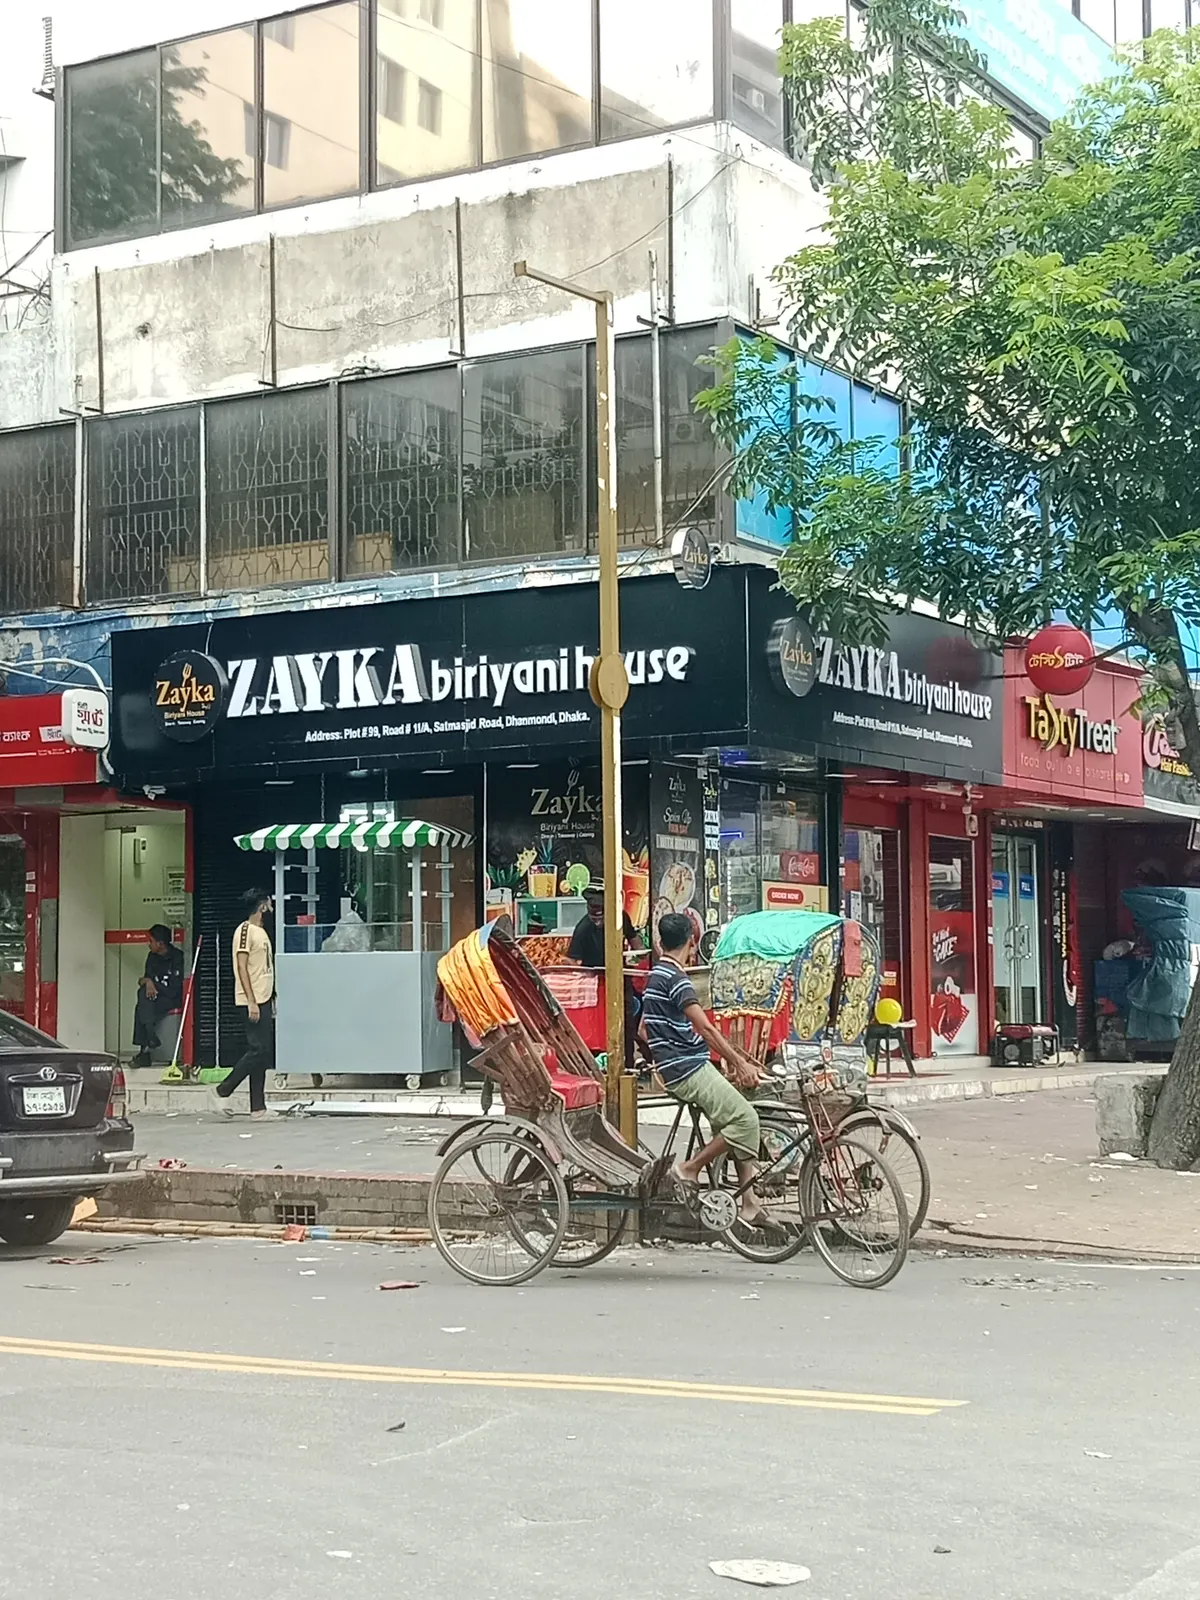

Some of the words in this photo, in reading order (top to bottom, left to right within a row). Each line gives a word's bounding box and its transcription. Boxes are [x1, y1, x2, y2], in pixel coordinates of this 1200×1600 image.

[783, 640, 812, 670] Zayka
[156, 677, 215, 712] Zayka
[227, 643, 424, 718] ZAYKA
[432, 648, 568, 706] biriyani
[575, 645, 690, 689] huse
[817, 636, 901, 700] ZAYKA
[954, 681, 992, 720] house
[305, 730, 343, 742] Address:
[344, 728, 361, 739] Plot
[382, 724, 404, 736] Road
[479, 716, 505, 729] Road,
[506, 712, 557, 727] Dhanmondi,
[559, 710, 591, 723] Dhaka.
